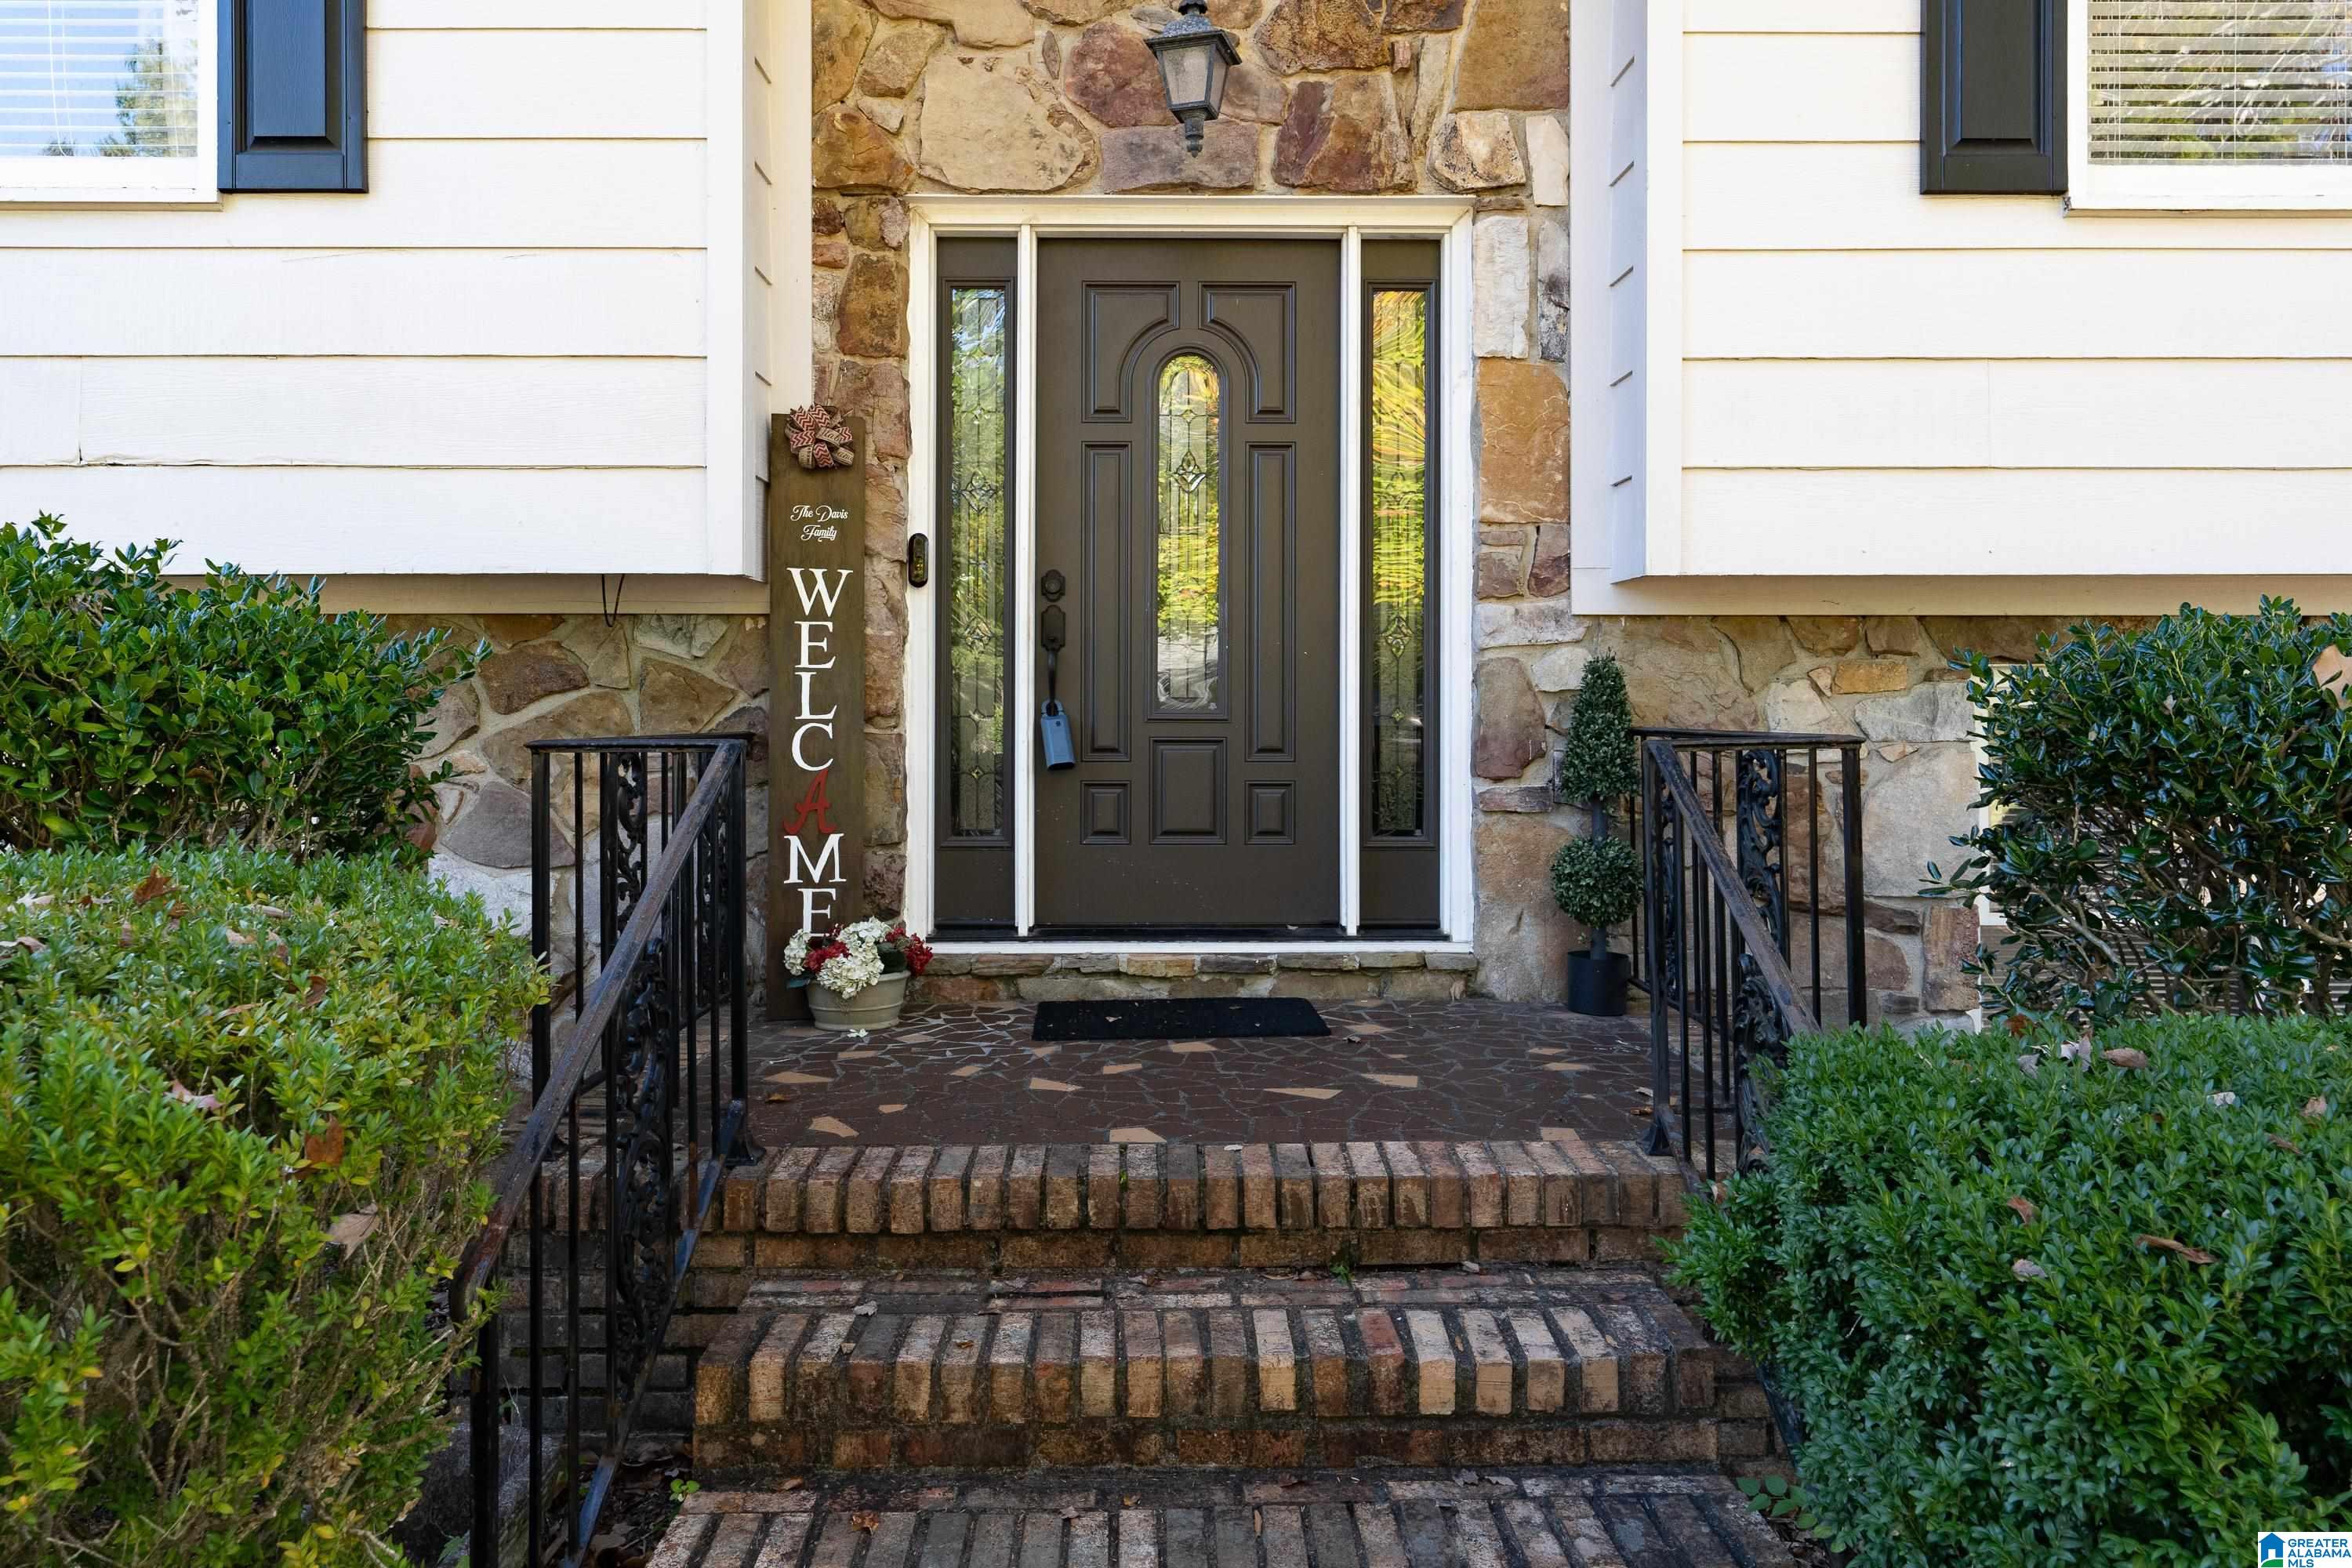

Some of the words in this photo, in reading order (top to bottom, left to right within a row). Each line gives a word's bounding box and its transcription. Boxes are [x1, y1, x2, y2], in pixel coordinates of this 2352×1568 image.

[790, 505, 814, 521] The
[815, 505, 848, 522] Davis
[800, 524, 837, 542] Family
